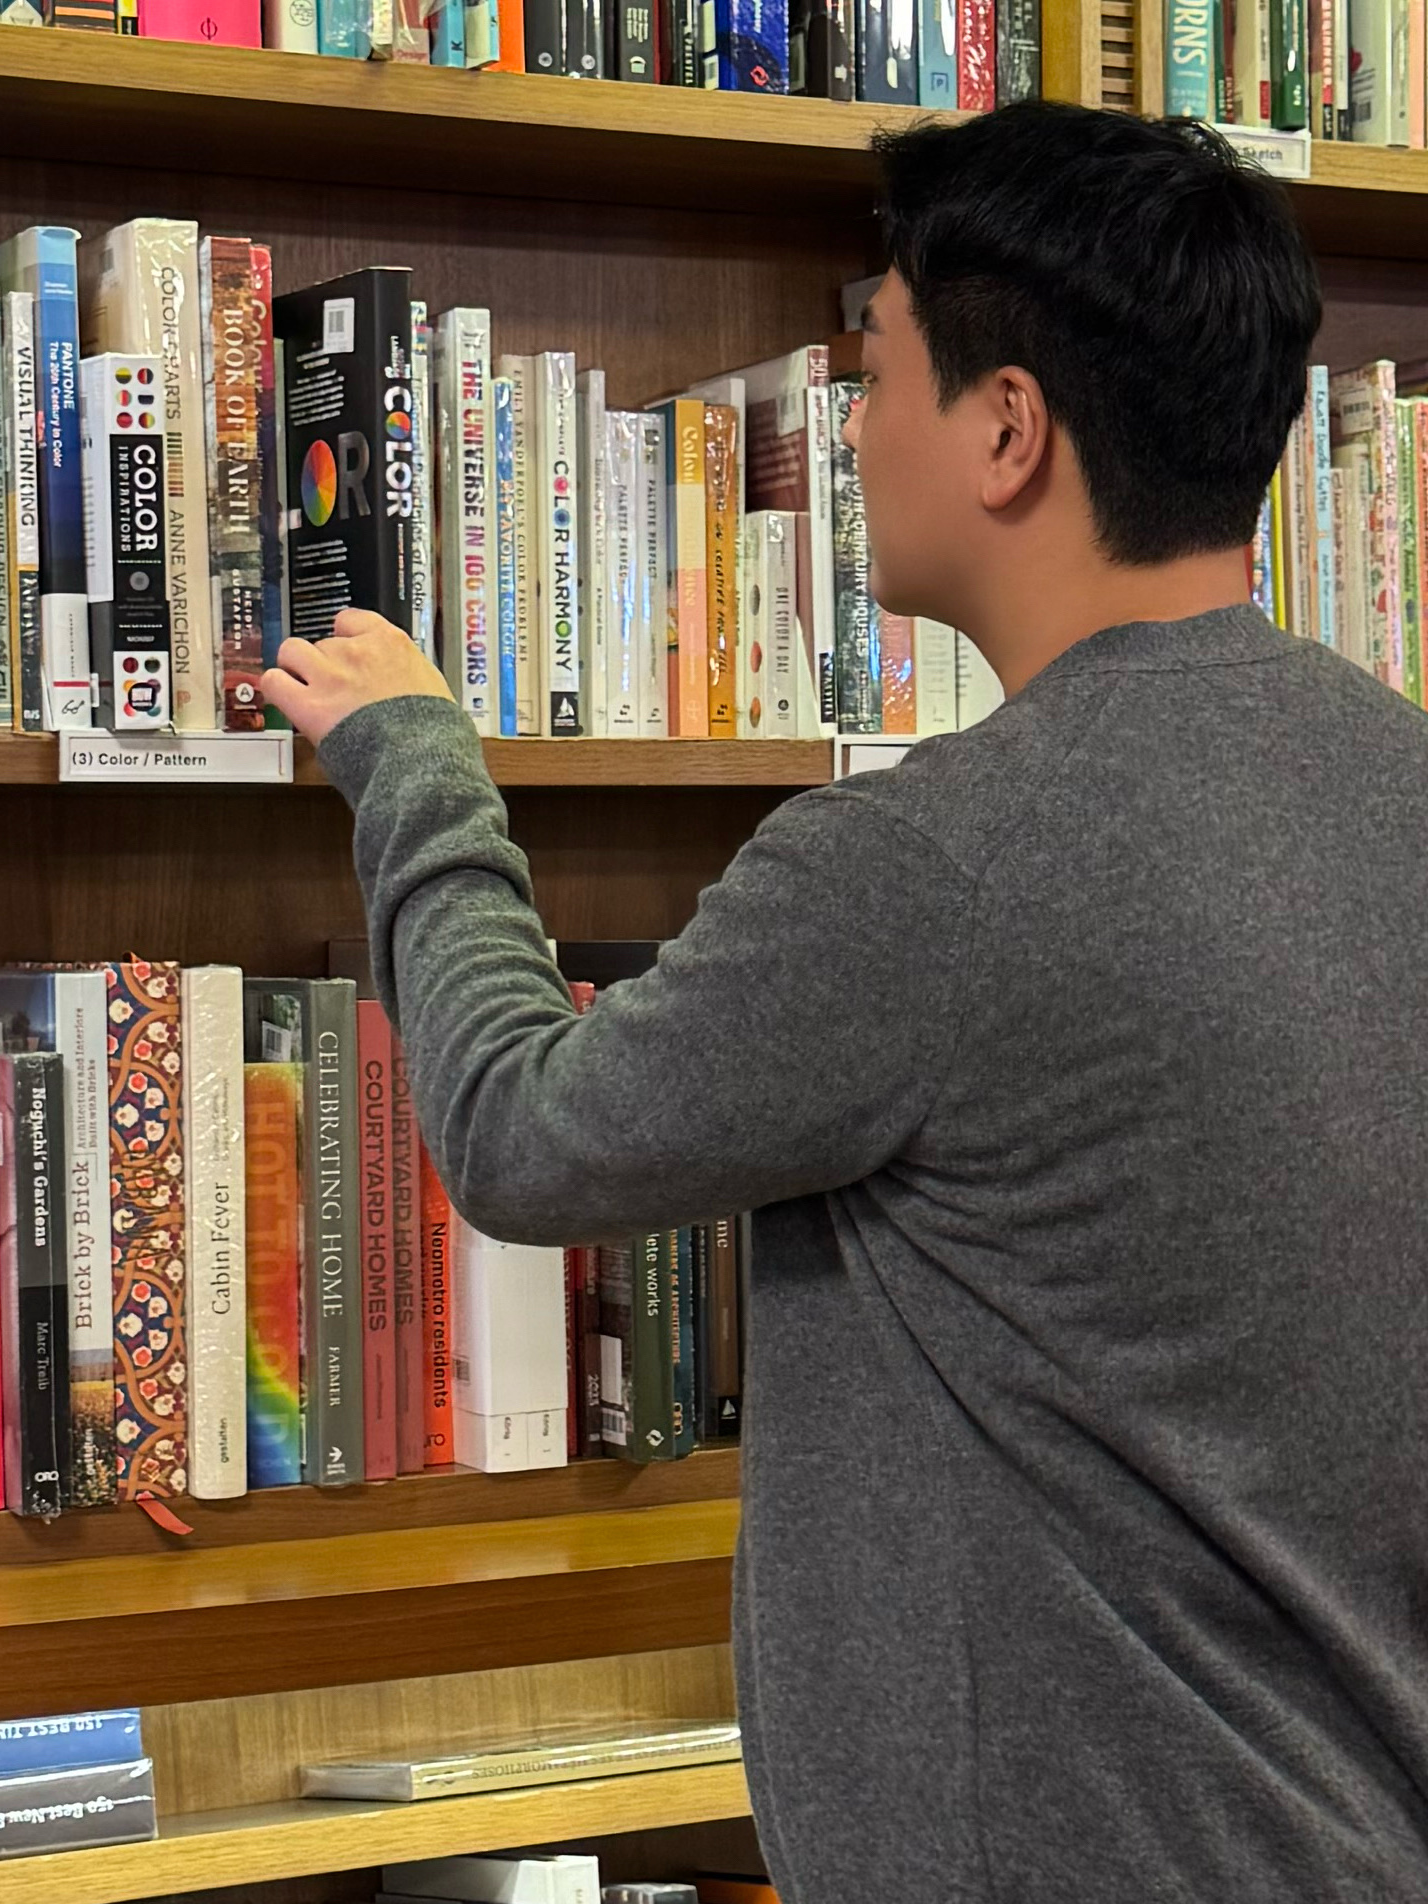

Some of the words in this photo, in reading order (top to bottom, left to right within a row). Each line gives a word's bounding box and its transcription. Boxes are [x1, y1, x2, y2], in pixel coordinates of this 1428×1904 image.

[222, 307, 245, 387] BOOK
[461, 358, 483, 401] THE
[226, 394, 247, 430] OF
[117, 445, 131, 553] INSPIRATIONS
[132, 444, 159, 553] COLOR
[227, 442, 251, 535] EARTH
[462, 408, 486, 518] UNIVERSE
[464, 525, 486, 549] IN
[465, 593, 488, 687] COLORS
[71, 751, 93, 768] (3)
[99, 752, 139, 767] Color
[155, 752, 207, 767] Pattern
[30, 1086, 48, 1171] Noguchi's
[318, 1031, 342, 1223] CELEBRATING
[365, 1060, 385, 1229] COURTYARD
[34, 1174, 48, 1248] Gardens
[215, 1182, 230, 1241] Fever
[211, 1243, 231, 1316] Cabin
[321, 1233, 343, 1319] HOME
[367, 1234, 387, 1332] HOMES
